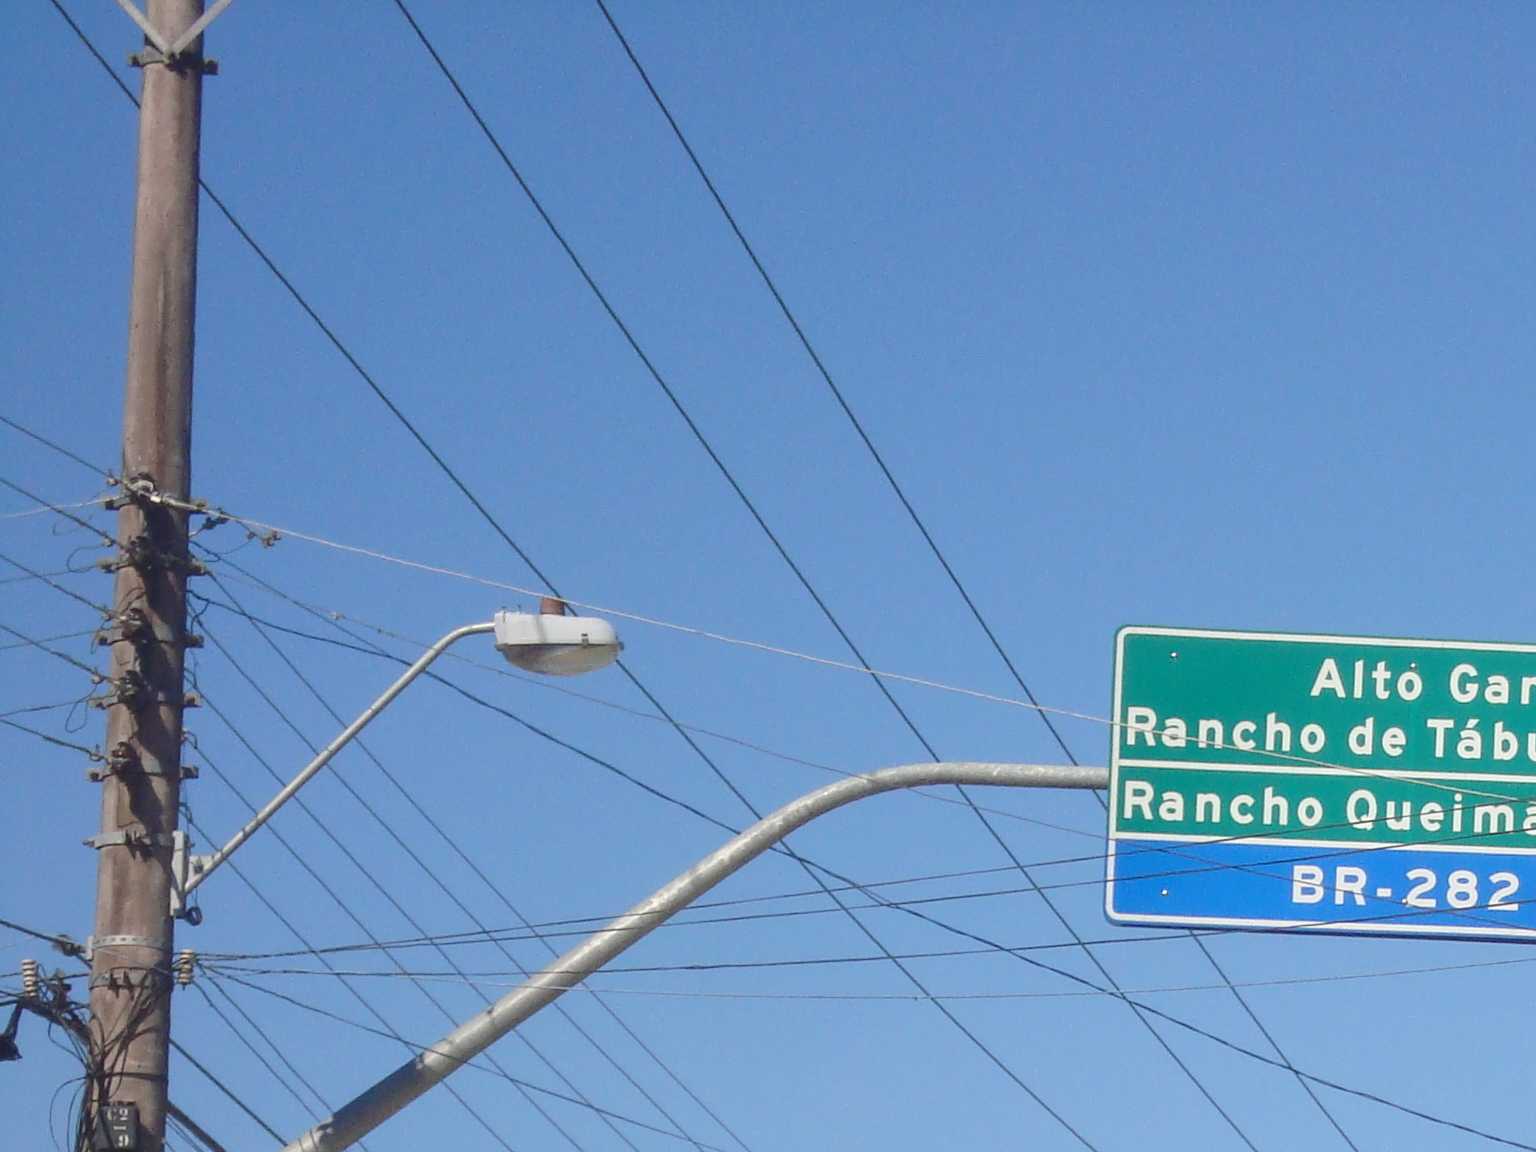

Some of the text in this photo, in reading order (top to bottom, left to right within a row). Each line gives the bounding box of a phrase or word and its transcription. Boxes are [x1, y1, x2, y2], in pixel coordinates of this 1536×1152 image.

[1311, 658, 1423, 701] Alto
[1126, 706, 1326, 753] Rancho
[1349, 717, 1407, 757] de
[1123, 780, 1324, 827] Rancho
[1292, 864, 1520, 911] BR-282
